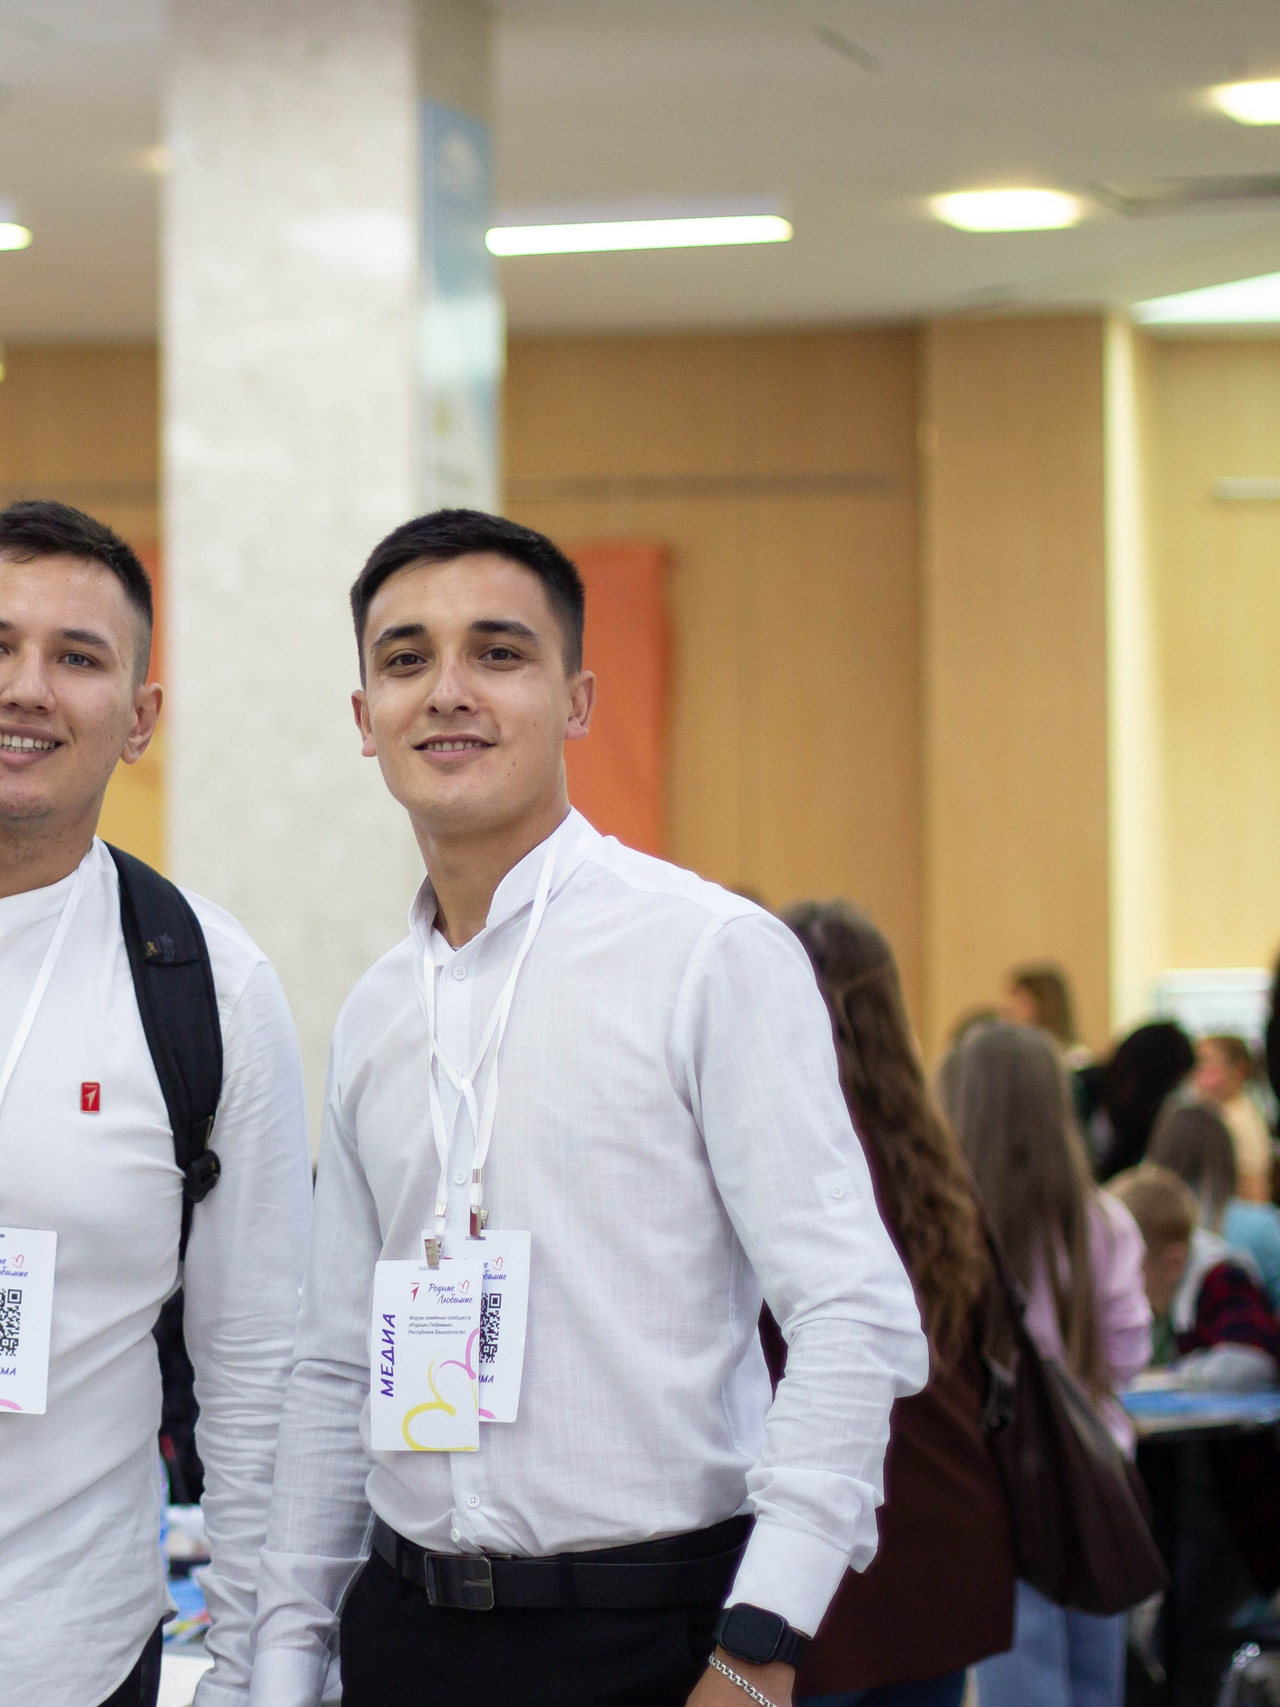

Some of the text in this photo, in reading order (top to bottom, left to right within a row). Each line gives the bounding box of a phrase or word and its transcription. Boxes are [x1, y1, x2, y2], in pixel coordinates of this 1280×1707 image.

[428, 1283, 455, 1296] Родные
[436, 1293, 473, 1304] Любимые
[380, 1313, 396, 1398] МЕДИА
